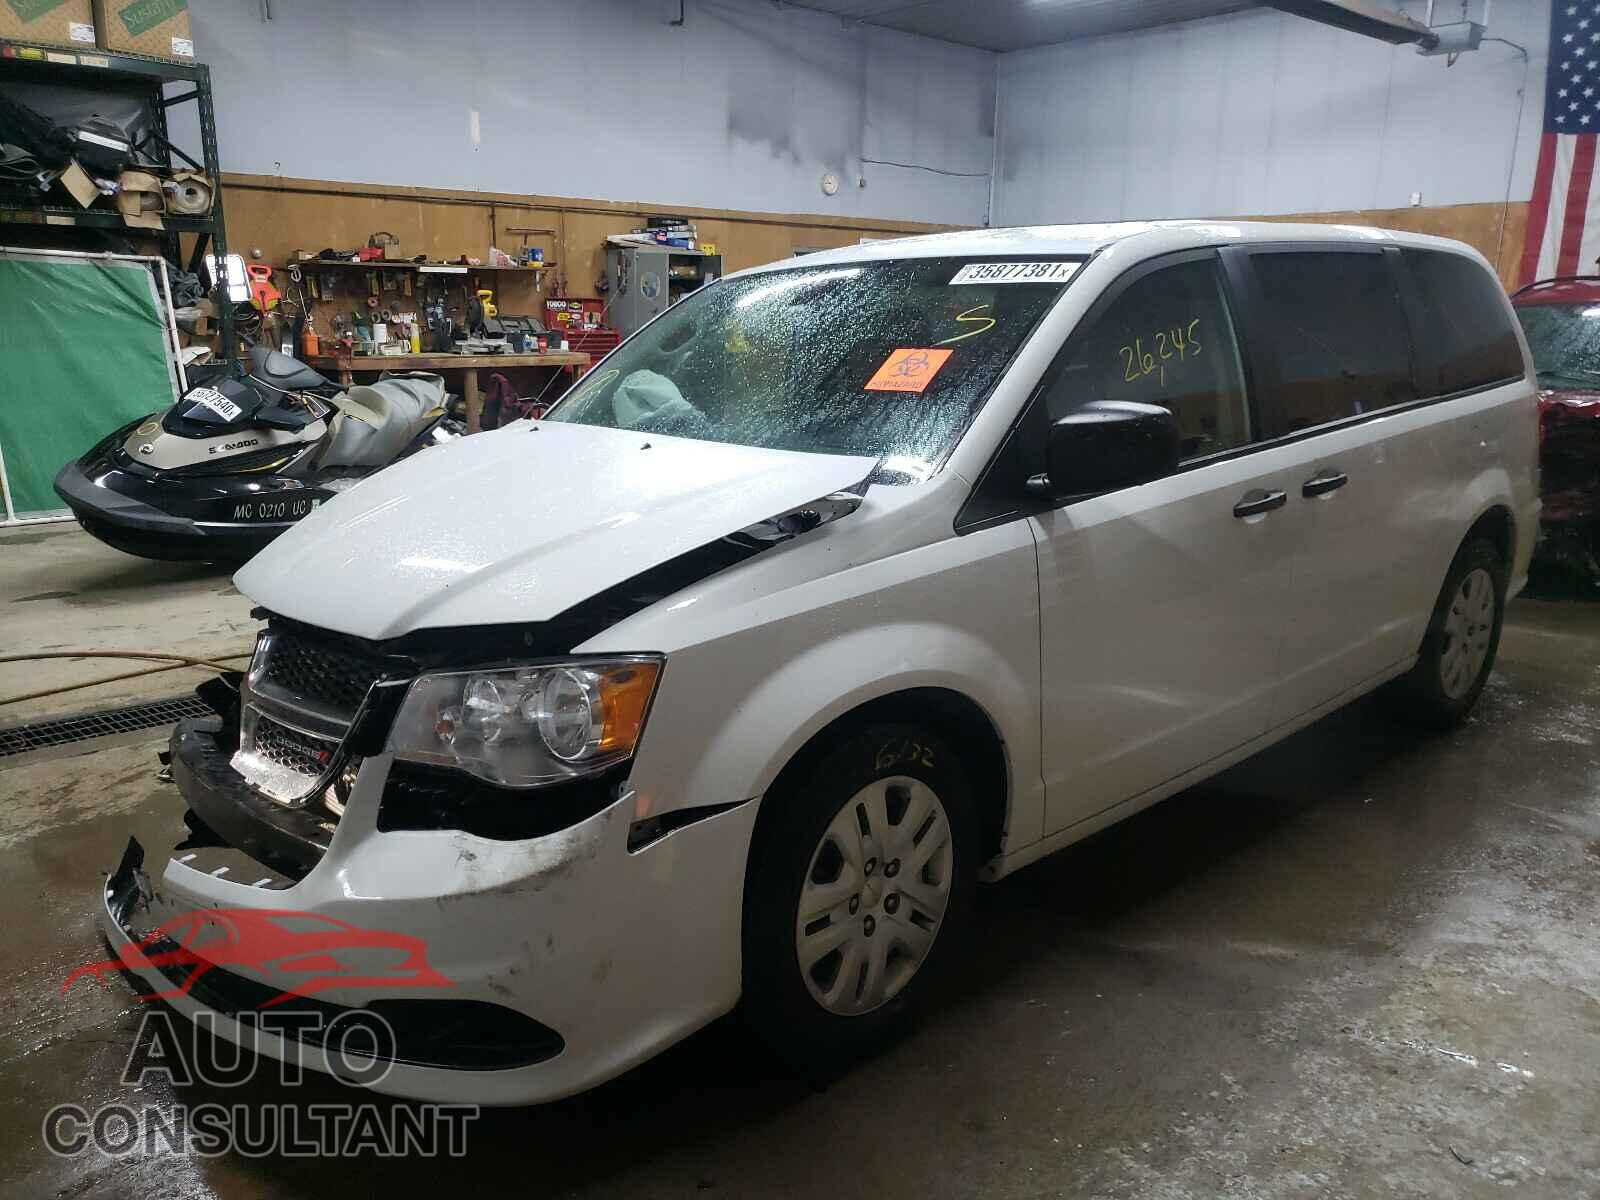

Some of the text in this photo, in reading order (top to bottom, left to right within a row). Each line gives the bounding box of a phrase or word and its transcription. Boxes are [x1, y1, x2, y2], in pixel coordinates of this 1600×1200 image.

[233, 503, 252, 520] MC
[259, 502, 285, 519] 0210
[292, 500, 306, 516] UC
